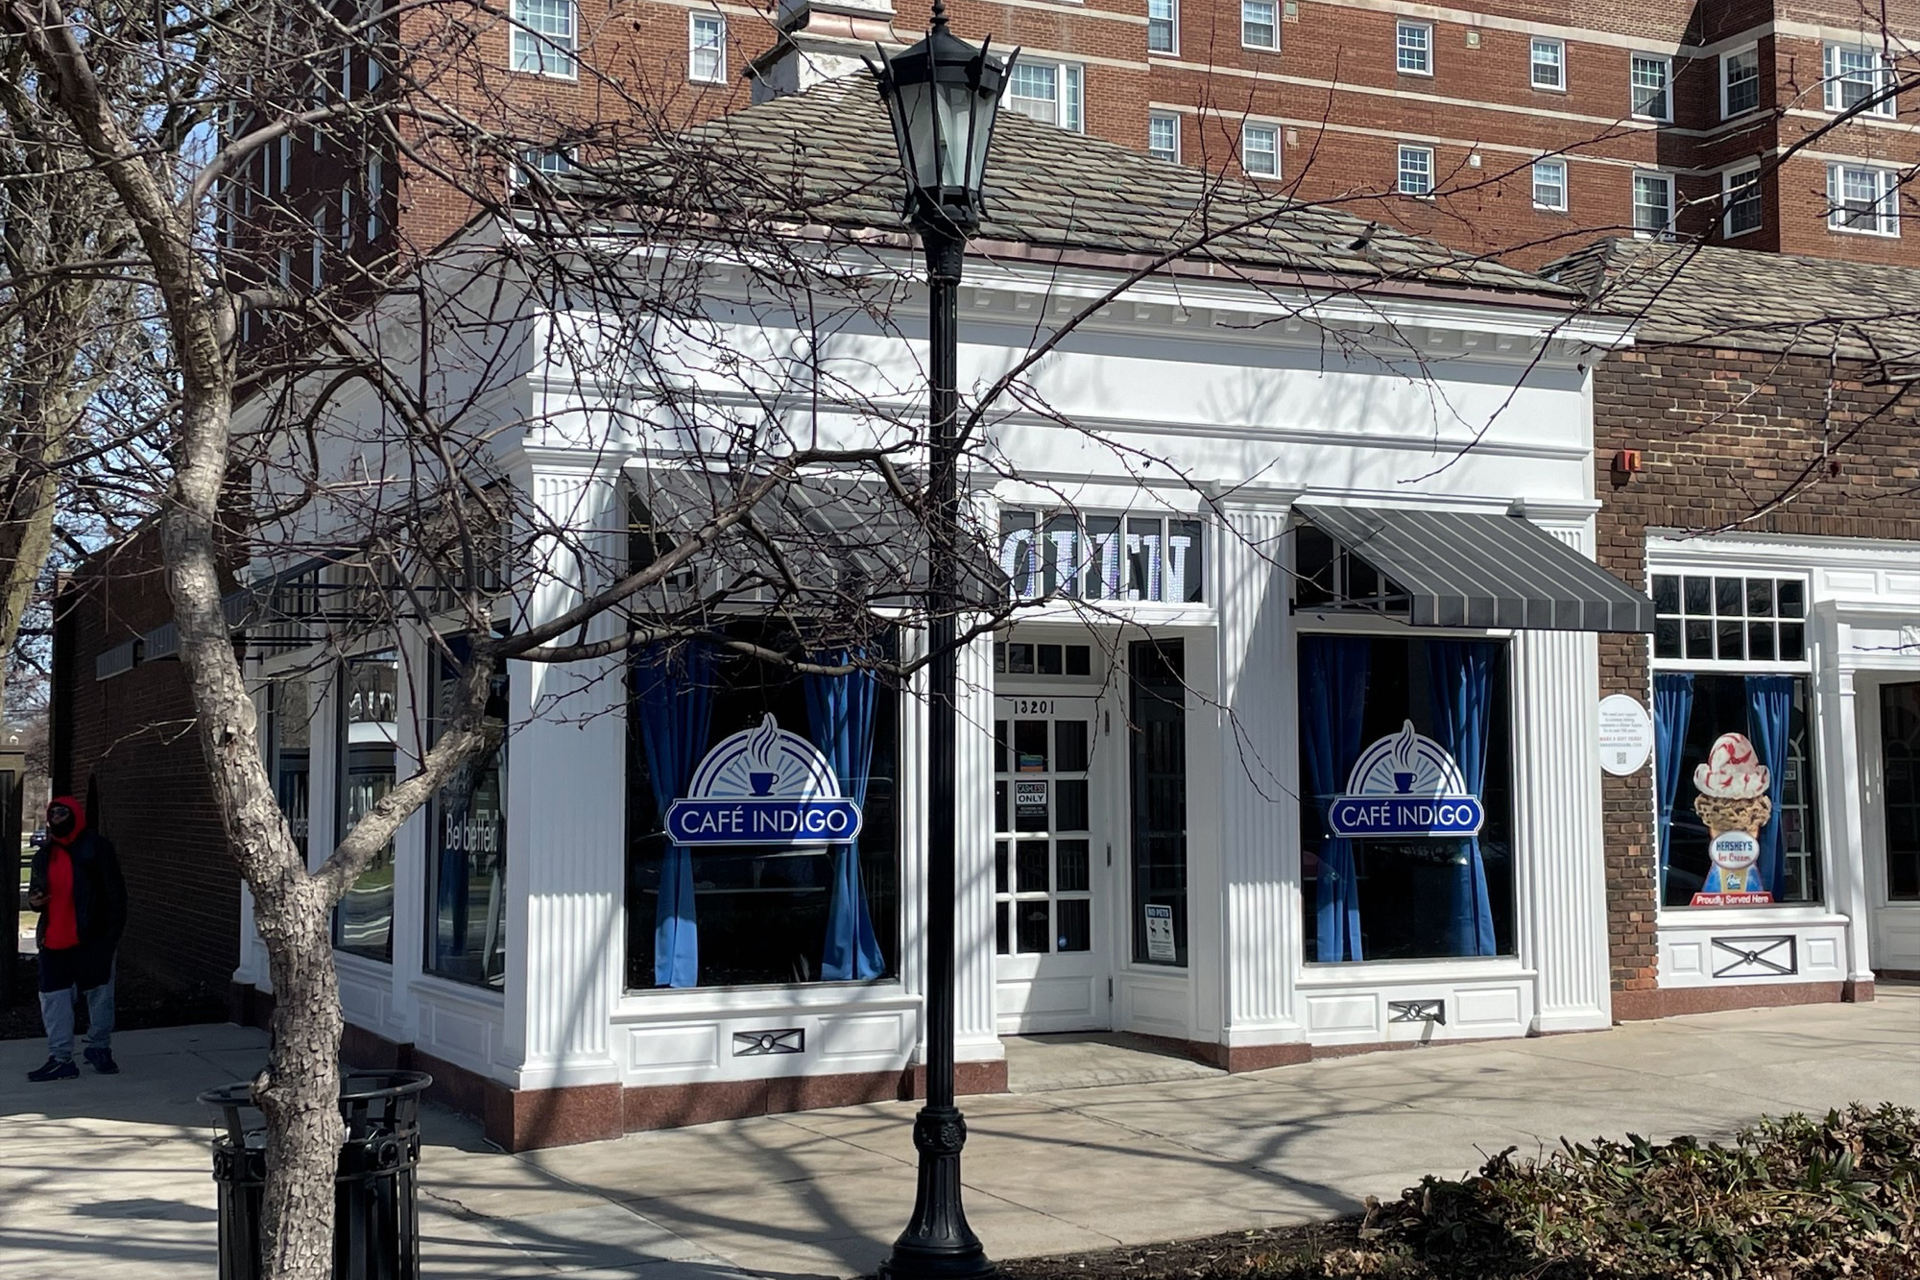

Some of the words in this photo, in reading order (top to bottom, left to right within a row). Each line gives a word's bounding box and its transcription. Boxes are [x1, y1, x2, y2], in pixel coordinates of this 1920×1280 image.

[1000, 528, 1191, 604] OPEN
[1014, 700, 1054, 715] 13201
[1017, 783, 1045, 793] CASHLESS
[1018, 794, 1044, 803] ONLY
[681, 805, 744, 834] CAFÉ
[753, 809, 848, 833] INDIGO
[1341, 801, 1391, 827] CAFÉ
[1397, 804, 1473, 826] INDIGO
[446, 812, 460, 851] Be
[463, 810, 498, 852] better.
[1716, 841, 1753, 852] HERSHEY'S
[1718, 852, 1727, 862] Ice
[1728, 852, 1752, 862] Cream
[1697, 895, 1725, 906] Proudly
[1725, 894, 1751, 904] Served
[1752, 894, 1769, 904] Here
